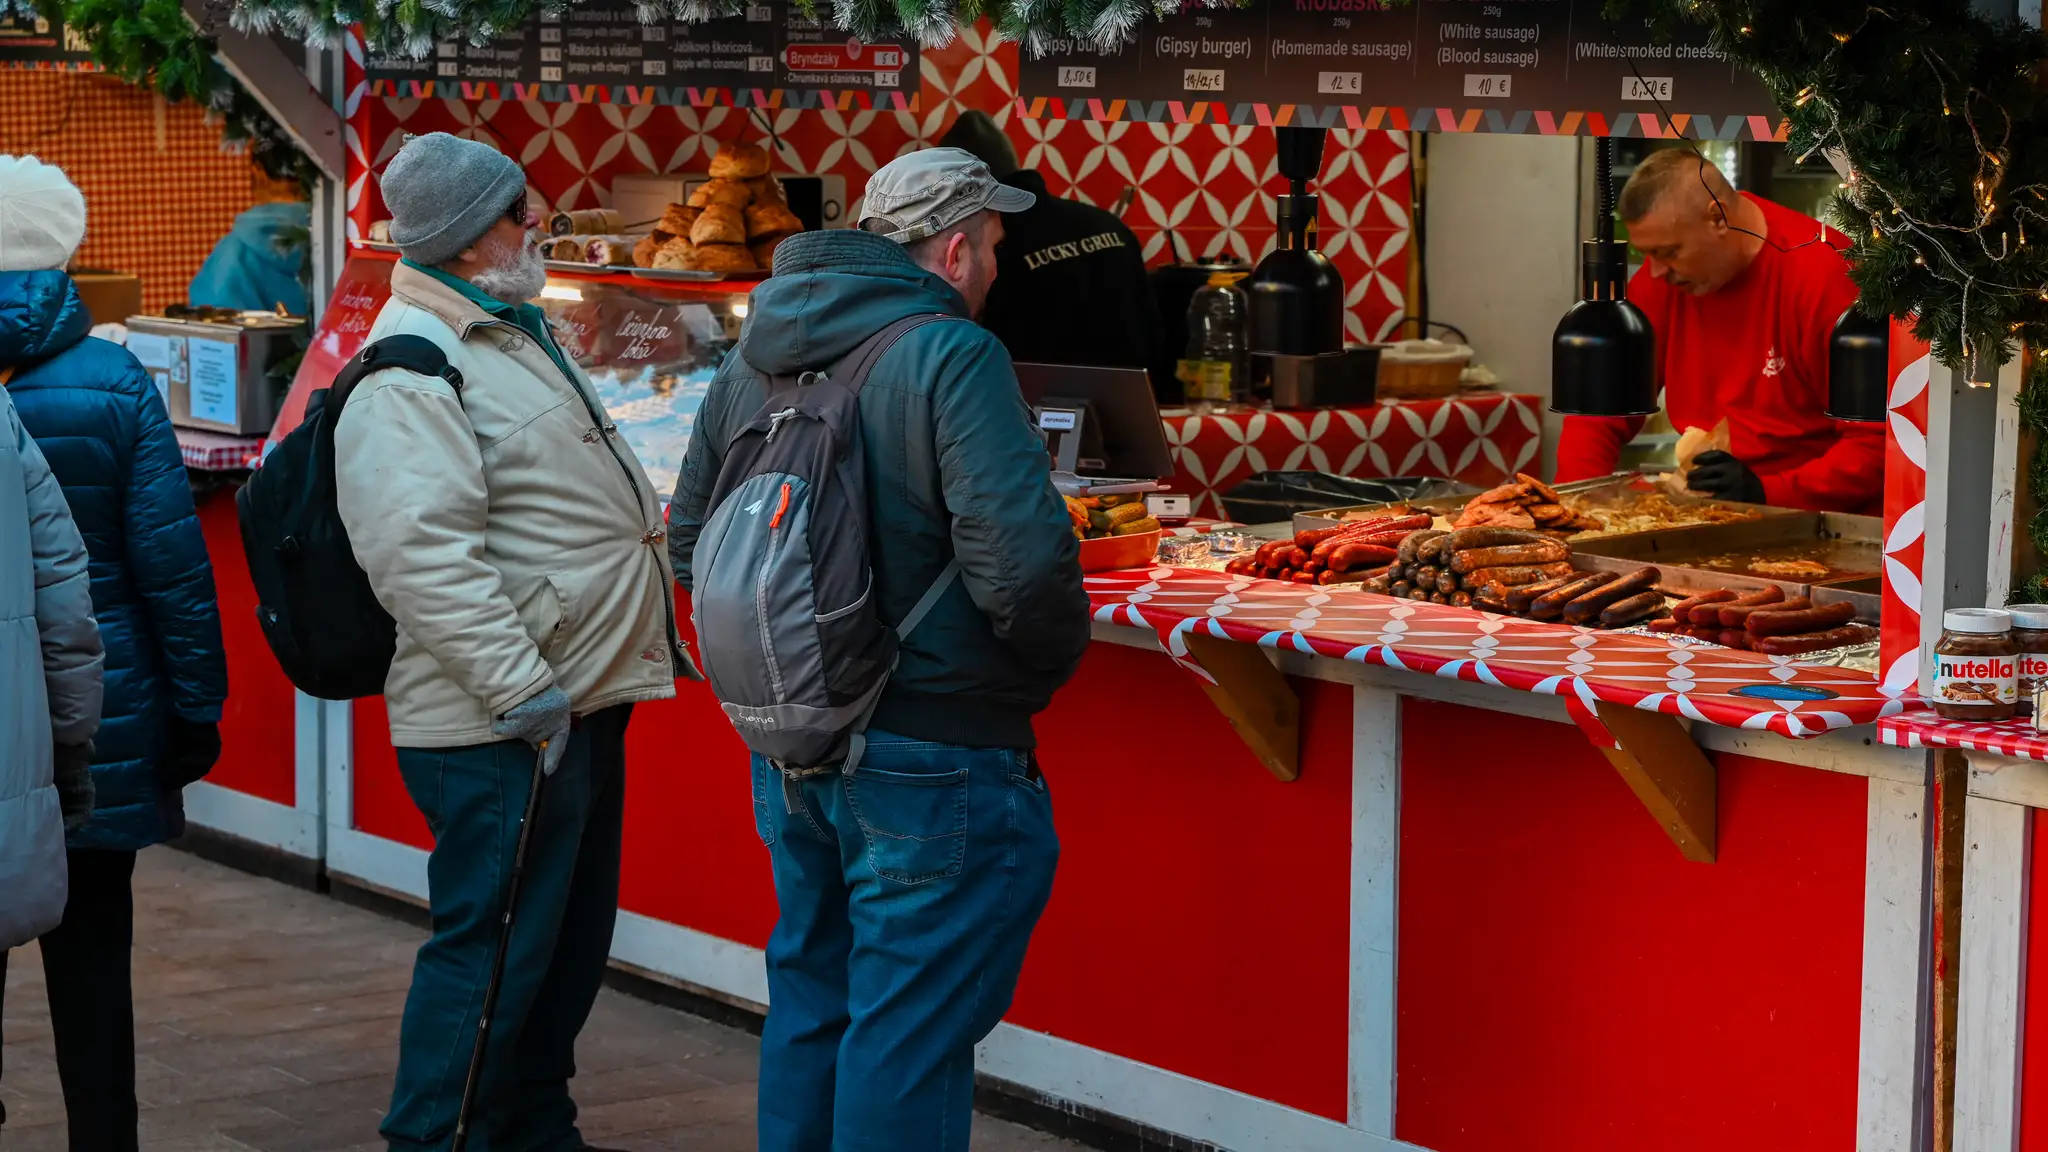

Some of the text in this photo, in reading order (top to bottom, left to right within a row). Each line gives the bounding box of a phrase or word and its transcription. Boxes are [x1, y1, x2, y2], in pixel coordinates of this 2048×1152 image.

[1483, 6, 1502, 17] 250g
[1196, 17, 1212, 27] 350g
[1333, 17, 1351, 29] 250g
[1440, 23, 1540, 43] (White sausage)
[1156, 36, 1252, 59] (Gipsy burger)
[1272, 39, 1412, 61] (Homemade sausage)
[1575, 43, 1671, 61] (White/smoked
[790, 51, 840, 68] Bryndzáky
[892, 54, 897, 64] €
[1437, 48, 1539, 68] (Blood sausage)
[892, 74, 897, 84] €
[1330, 75, 1357, 90] 12 €
[1478, 78, 1506, 95] 10 €
[1024, 232, 1126, 271] LUCKY GRILL
[1941, 658, 2013, 679] nutella
